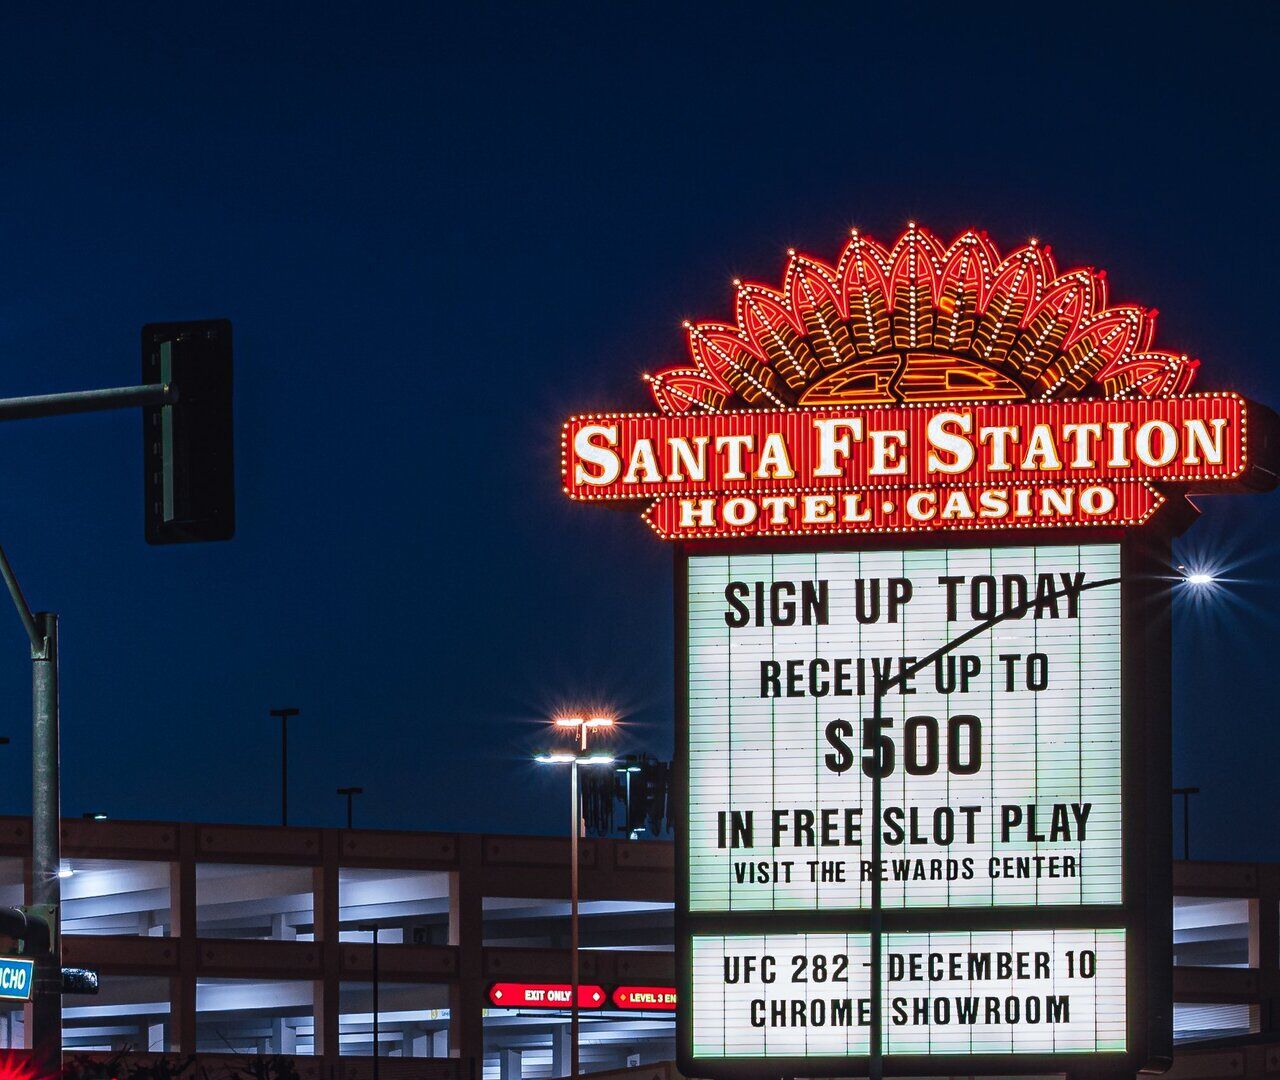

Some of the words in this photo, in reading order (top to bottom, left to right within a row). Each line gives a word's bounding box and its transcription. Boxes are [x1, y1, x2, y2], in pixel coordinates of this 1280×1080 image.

[573, 423, 795, 487] SANTA
[812, 416, 908, 478] FE
[926, 411, 1228, 475] STATION
[678, 493, 872, 527] HOTEL
[906, 487, 1116, 521] CASINO
[724, 579, 829, 628] SIGN
[854, 577, 913, 625] UP
[938, 572, 1087, 622] TODAY
[760, 656, 918, 698] RECEIVE
[934, 654, 981, 694] UP
[999, 652, 1049, 692] TO
[824, 714, 982, 779] $500
[718, 810, 754, 849] IN
[771, 808, 863, 847] FREE
[882, 805, 982, 847] SLOT
[1000, 803, 1092, 843] PLAY
[734, 861, 795, 884] VISIT
[806, 860, 846, 883] THE
[860, 857, 974, 882] REWARDS
[988, 855, 1076, 878] CENTER
[724, 955, 776, 984] UFC
[791, 954, 848, 983] 282
[888, 951, 1050, 982] DECEMBER
[1065, 950, 1096, 979] 10
[524, 989, 545, 1001] EXIT
[547, 990, 572, 1002] ONLY
[629, 992, 656, 1003] LEVEL
[657, 994, 663, 1003] 3
[750, 998, 871, 1027] CHROME
[892, 995, 1070, 1026] SHOWROOM
